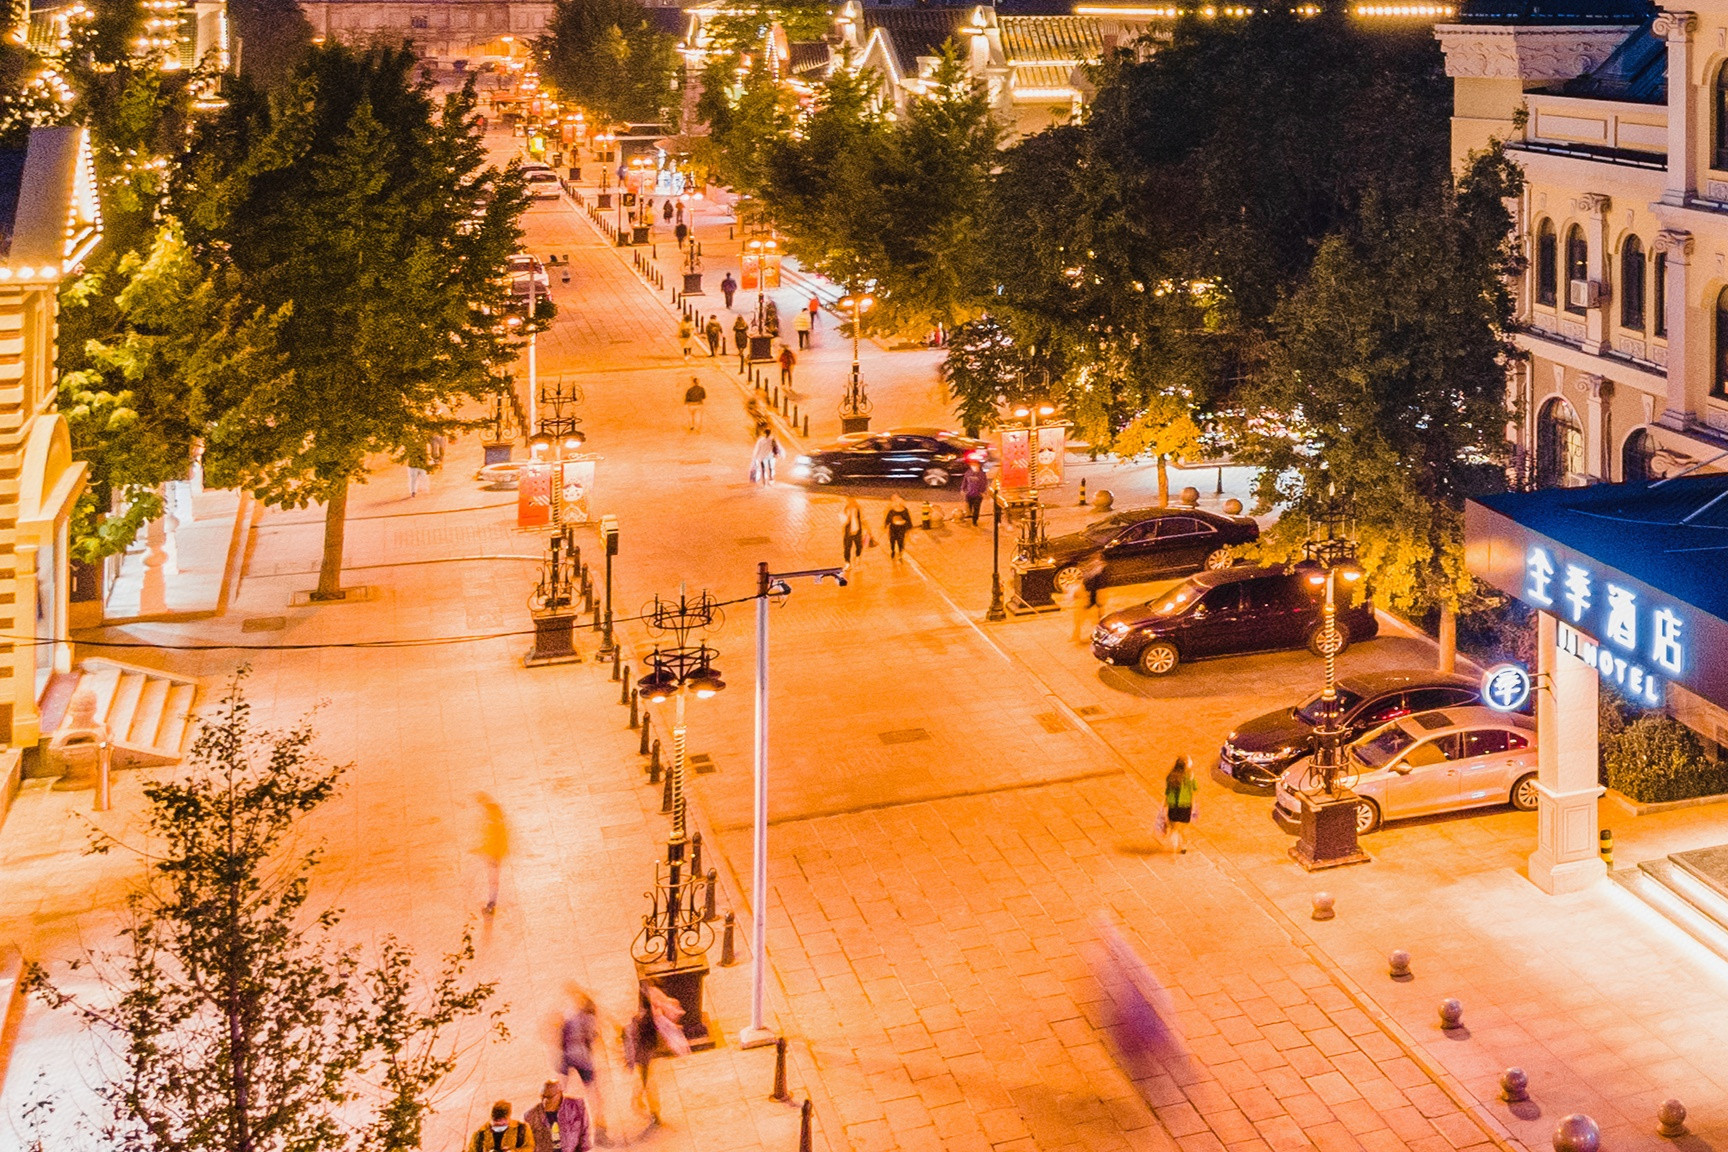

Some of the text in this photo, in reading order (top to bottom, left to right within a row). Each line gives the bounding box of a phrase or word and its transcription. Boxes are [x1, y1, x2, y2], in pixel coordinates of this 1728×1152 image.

[1527, 549, 1682, 673] 全季酒店
[1494, 671, 1522, 706] 季
[1583, 641, 1659, 703] HOTEL
